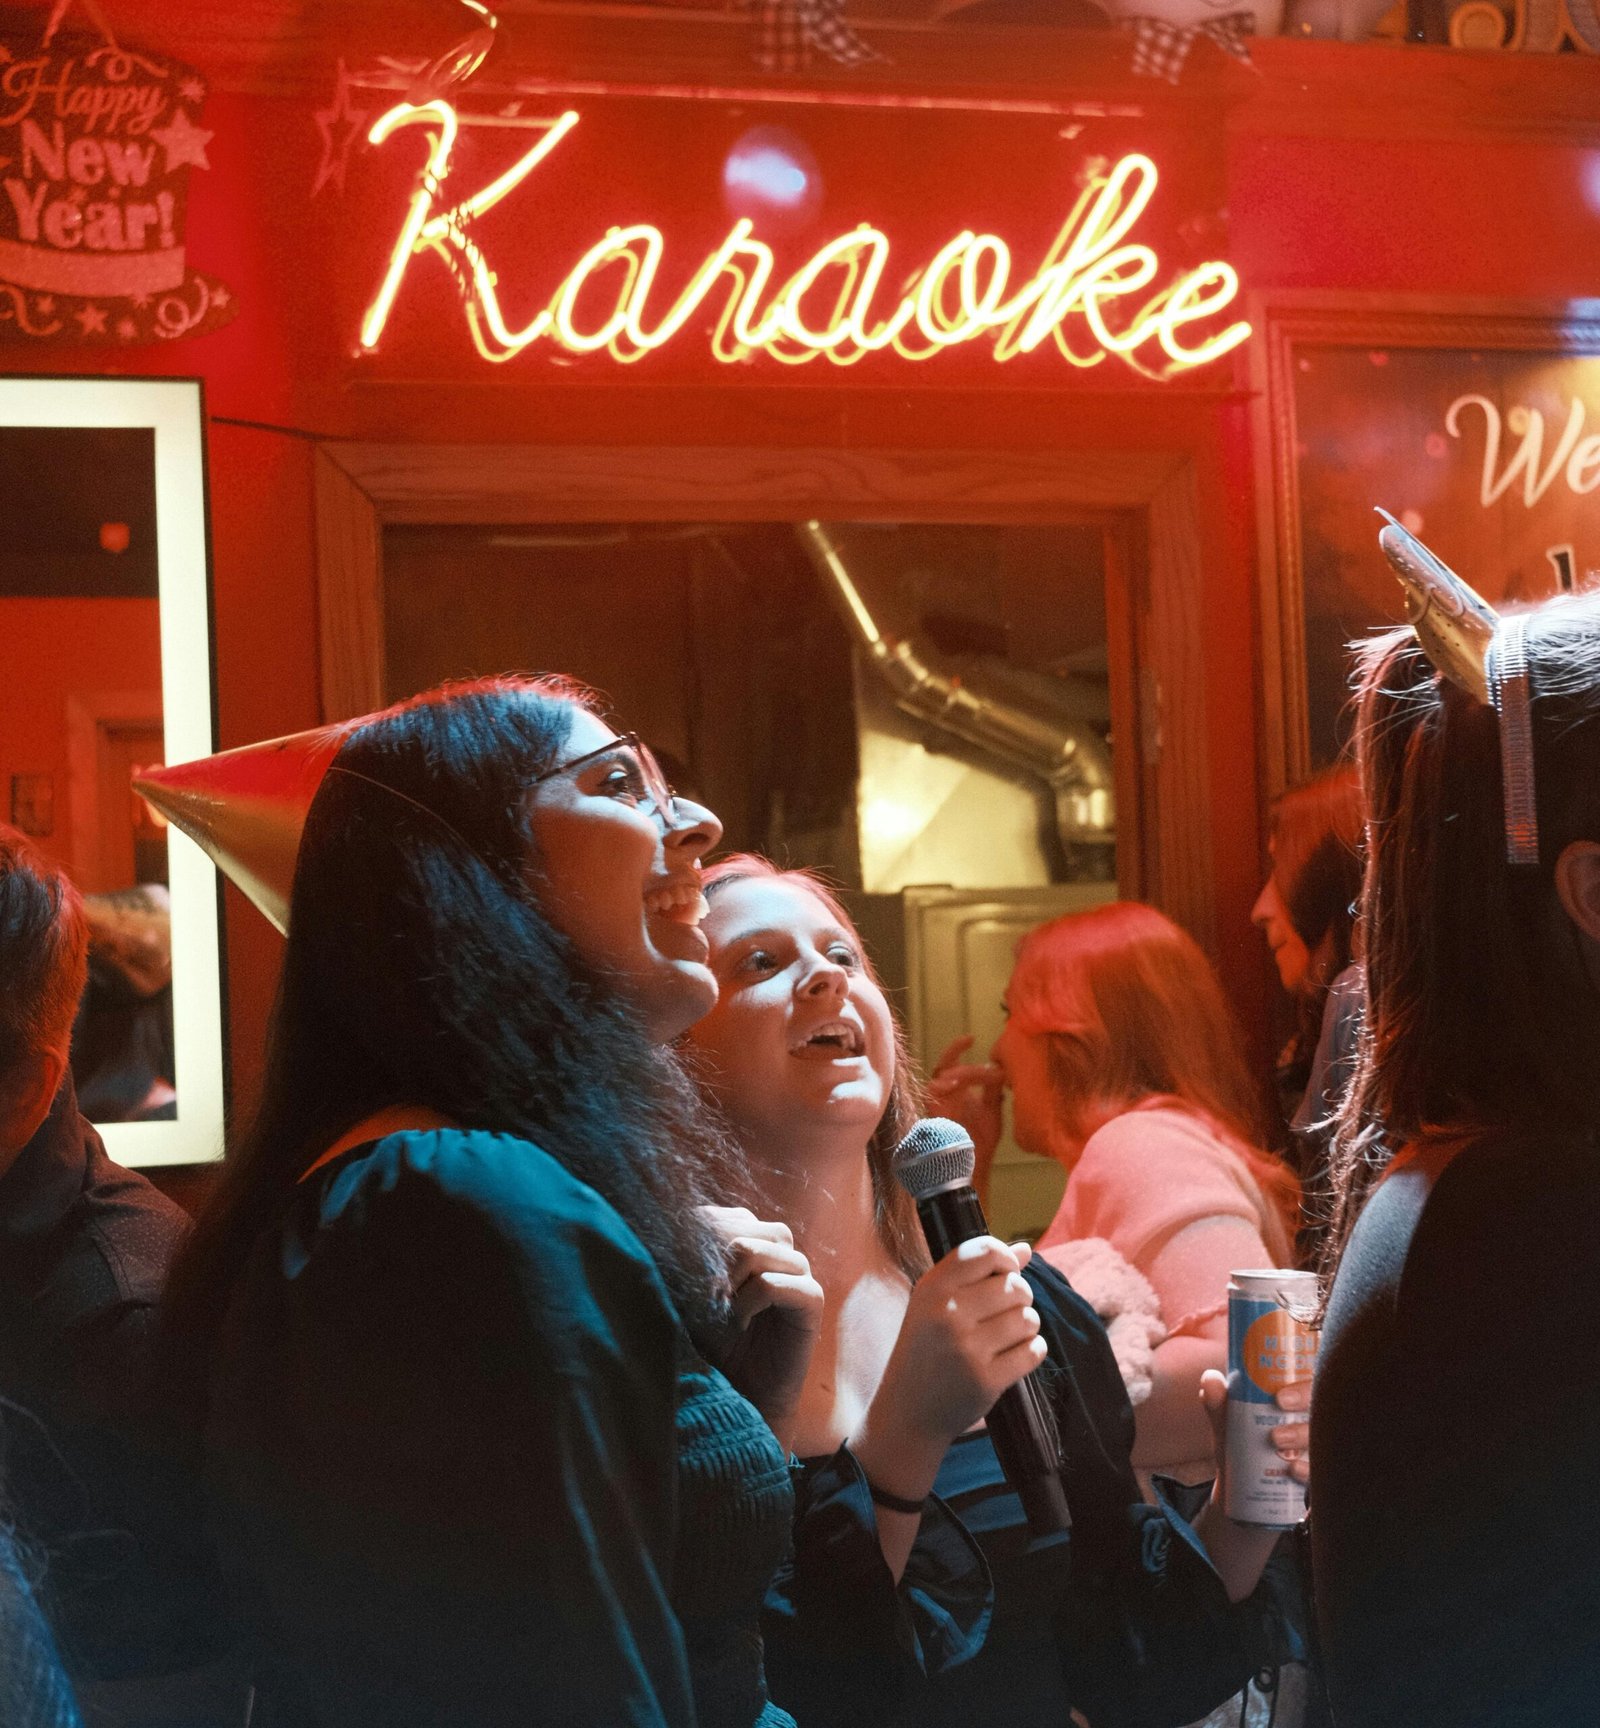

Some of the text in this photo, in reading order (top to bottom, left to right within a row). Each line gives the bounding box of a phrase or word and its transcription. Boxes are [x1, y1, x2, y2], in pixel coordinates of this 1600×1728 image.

[0, 56, 168, 136] Happy
[19, 118, 156, 187] New
[3, 179, 175, 250] Year!
[360, 98, 1254, 379] Karaoke
